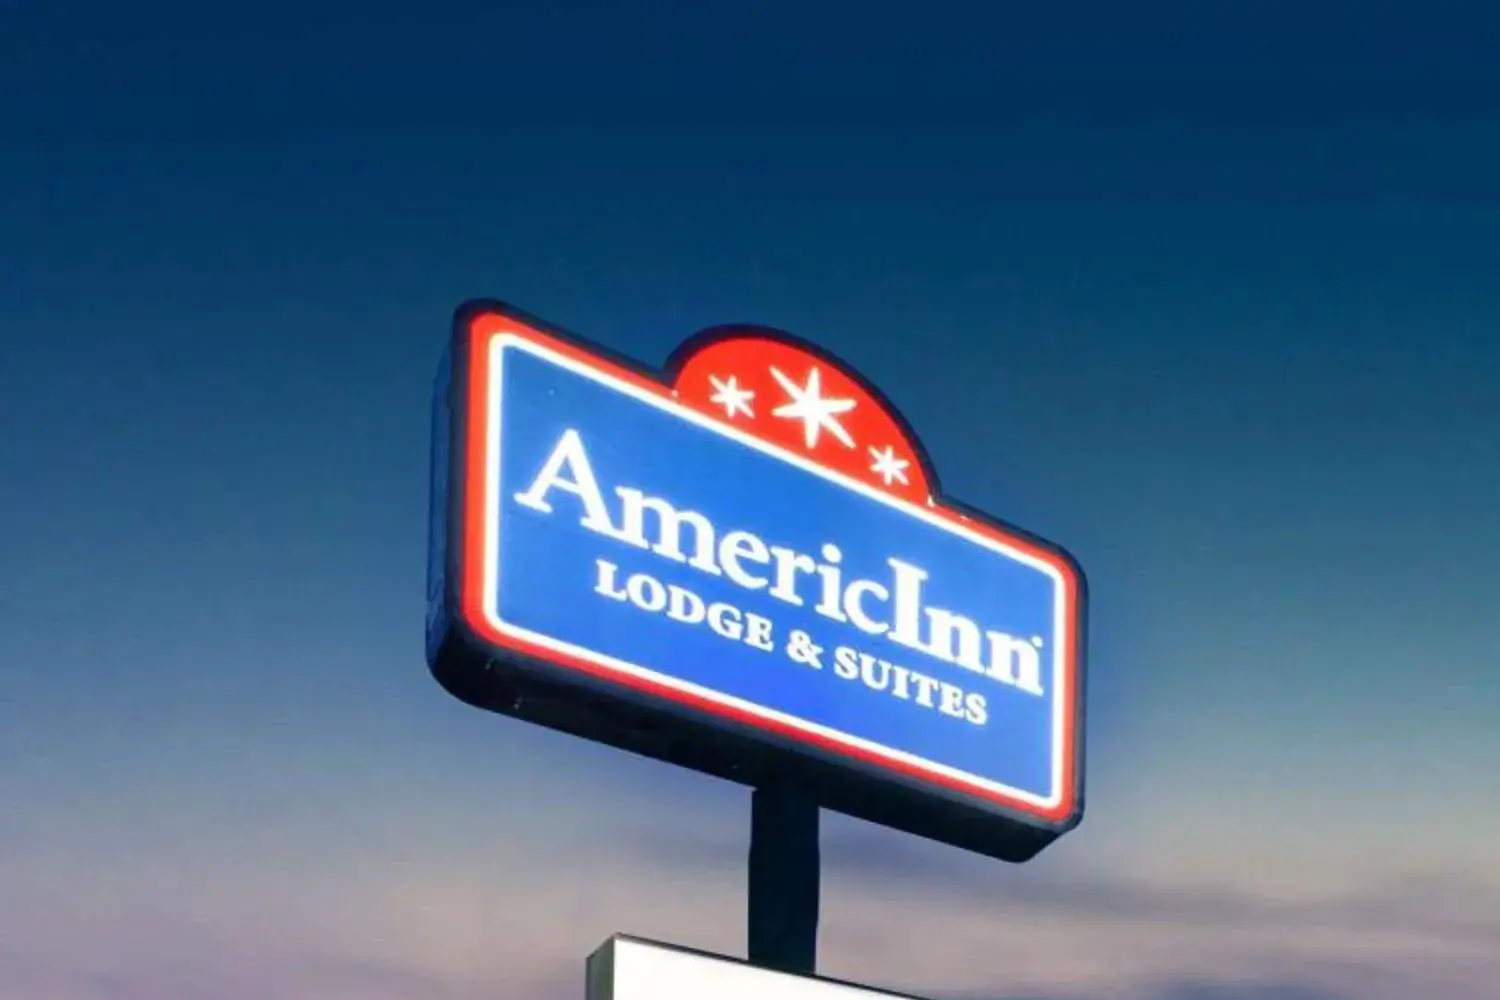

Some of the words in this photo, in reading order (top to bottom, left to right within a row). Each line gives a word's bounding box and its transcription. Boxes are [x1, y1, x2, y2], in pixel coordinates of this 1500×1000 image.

[514, 429, 1043, 697] AmericInn
[594, 560, 774, 652] LODGE
[787, 631, 822, 669] &
[834, 646, 988, 725] SUITES
